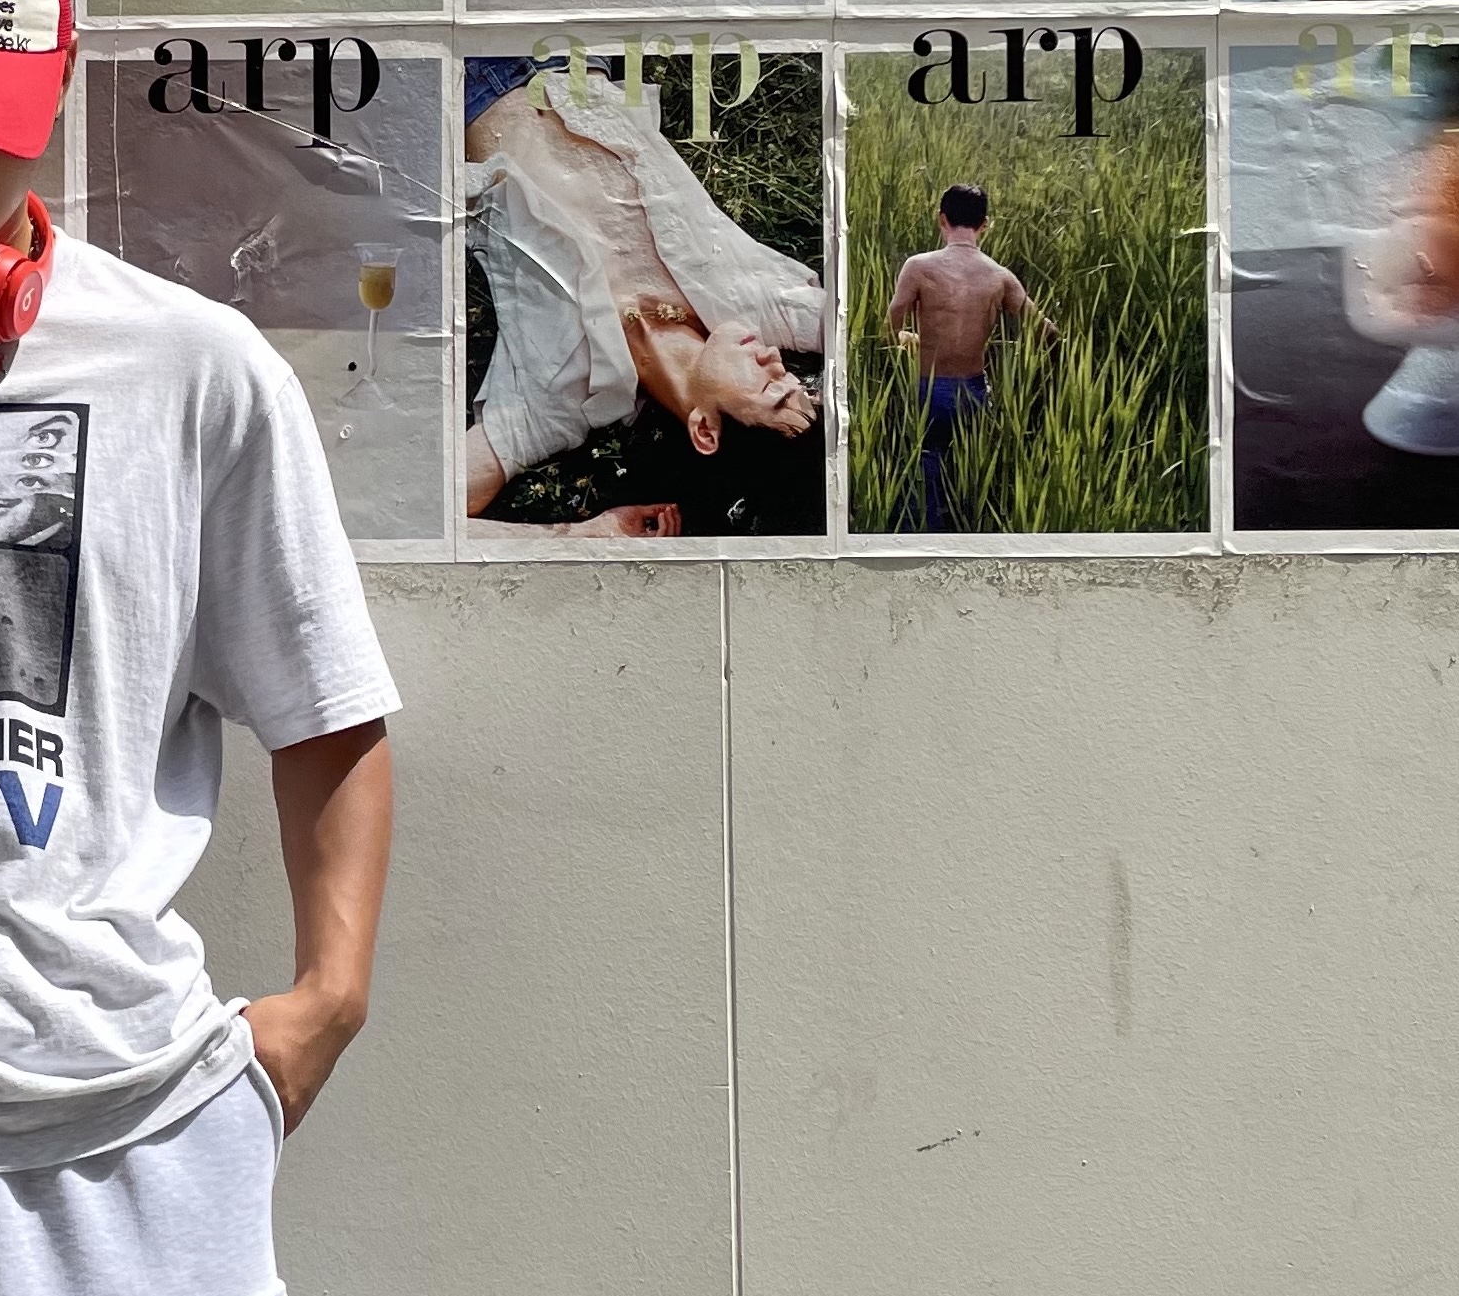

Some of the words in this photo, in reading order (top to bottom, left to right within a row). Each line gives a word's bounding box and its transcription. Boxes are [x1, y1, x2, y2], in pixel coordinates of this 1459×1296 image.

[147, 36, 381, 150] arp
[526, 32, 761, 143] arp
[907, 26, 1143, 138] arp
[1293, 22, 1459, 133] ar
